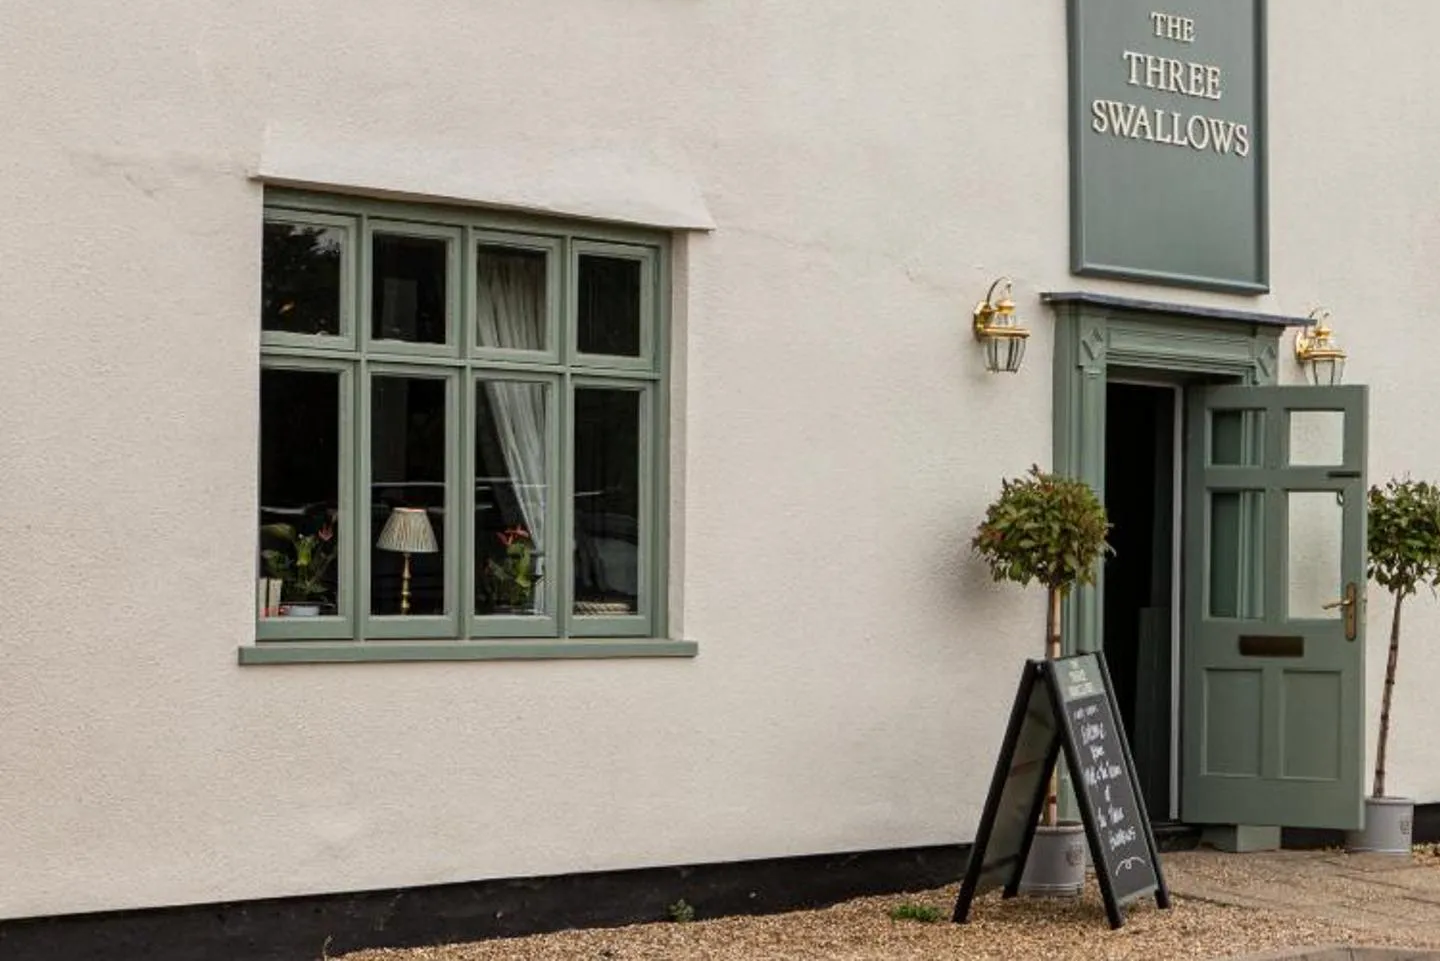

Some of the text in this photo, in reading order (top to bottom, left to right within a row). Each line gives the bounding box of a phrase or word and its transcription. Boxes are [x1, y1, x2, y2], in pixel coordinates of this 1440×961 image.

[1151, 11, 1195, 43] THE
[1123, 51, 1222, 100] THREE
[1092, 100, 1250, 157] SWALLOWS
